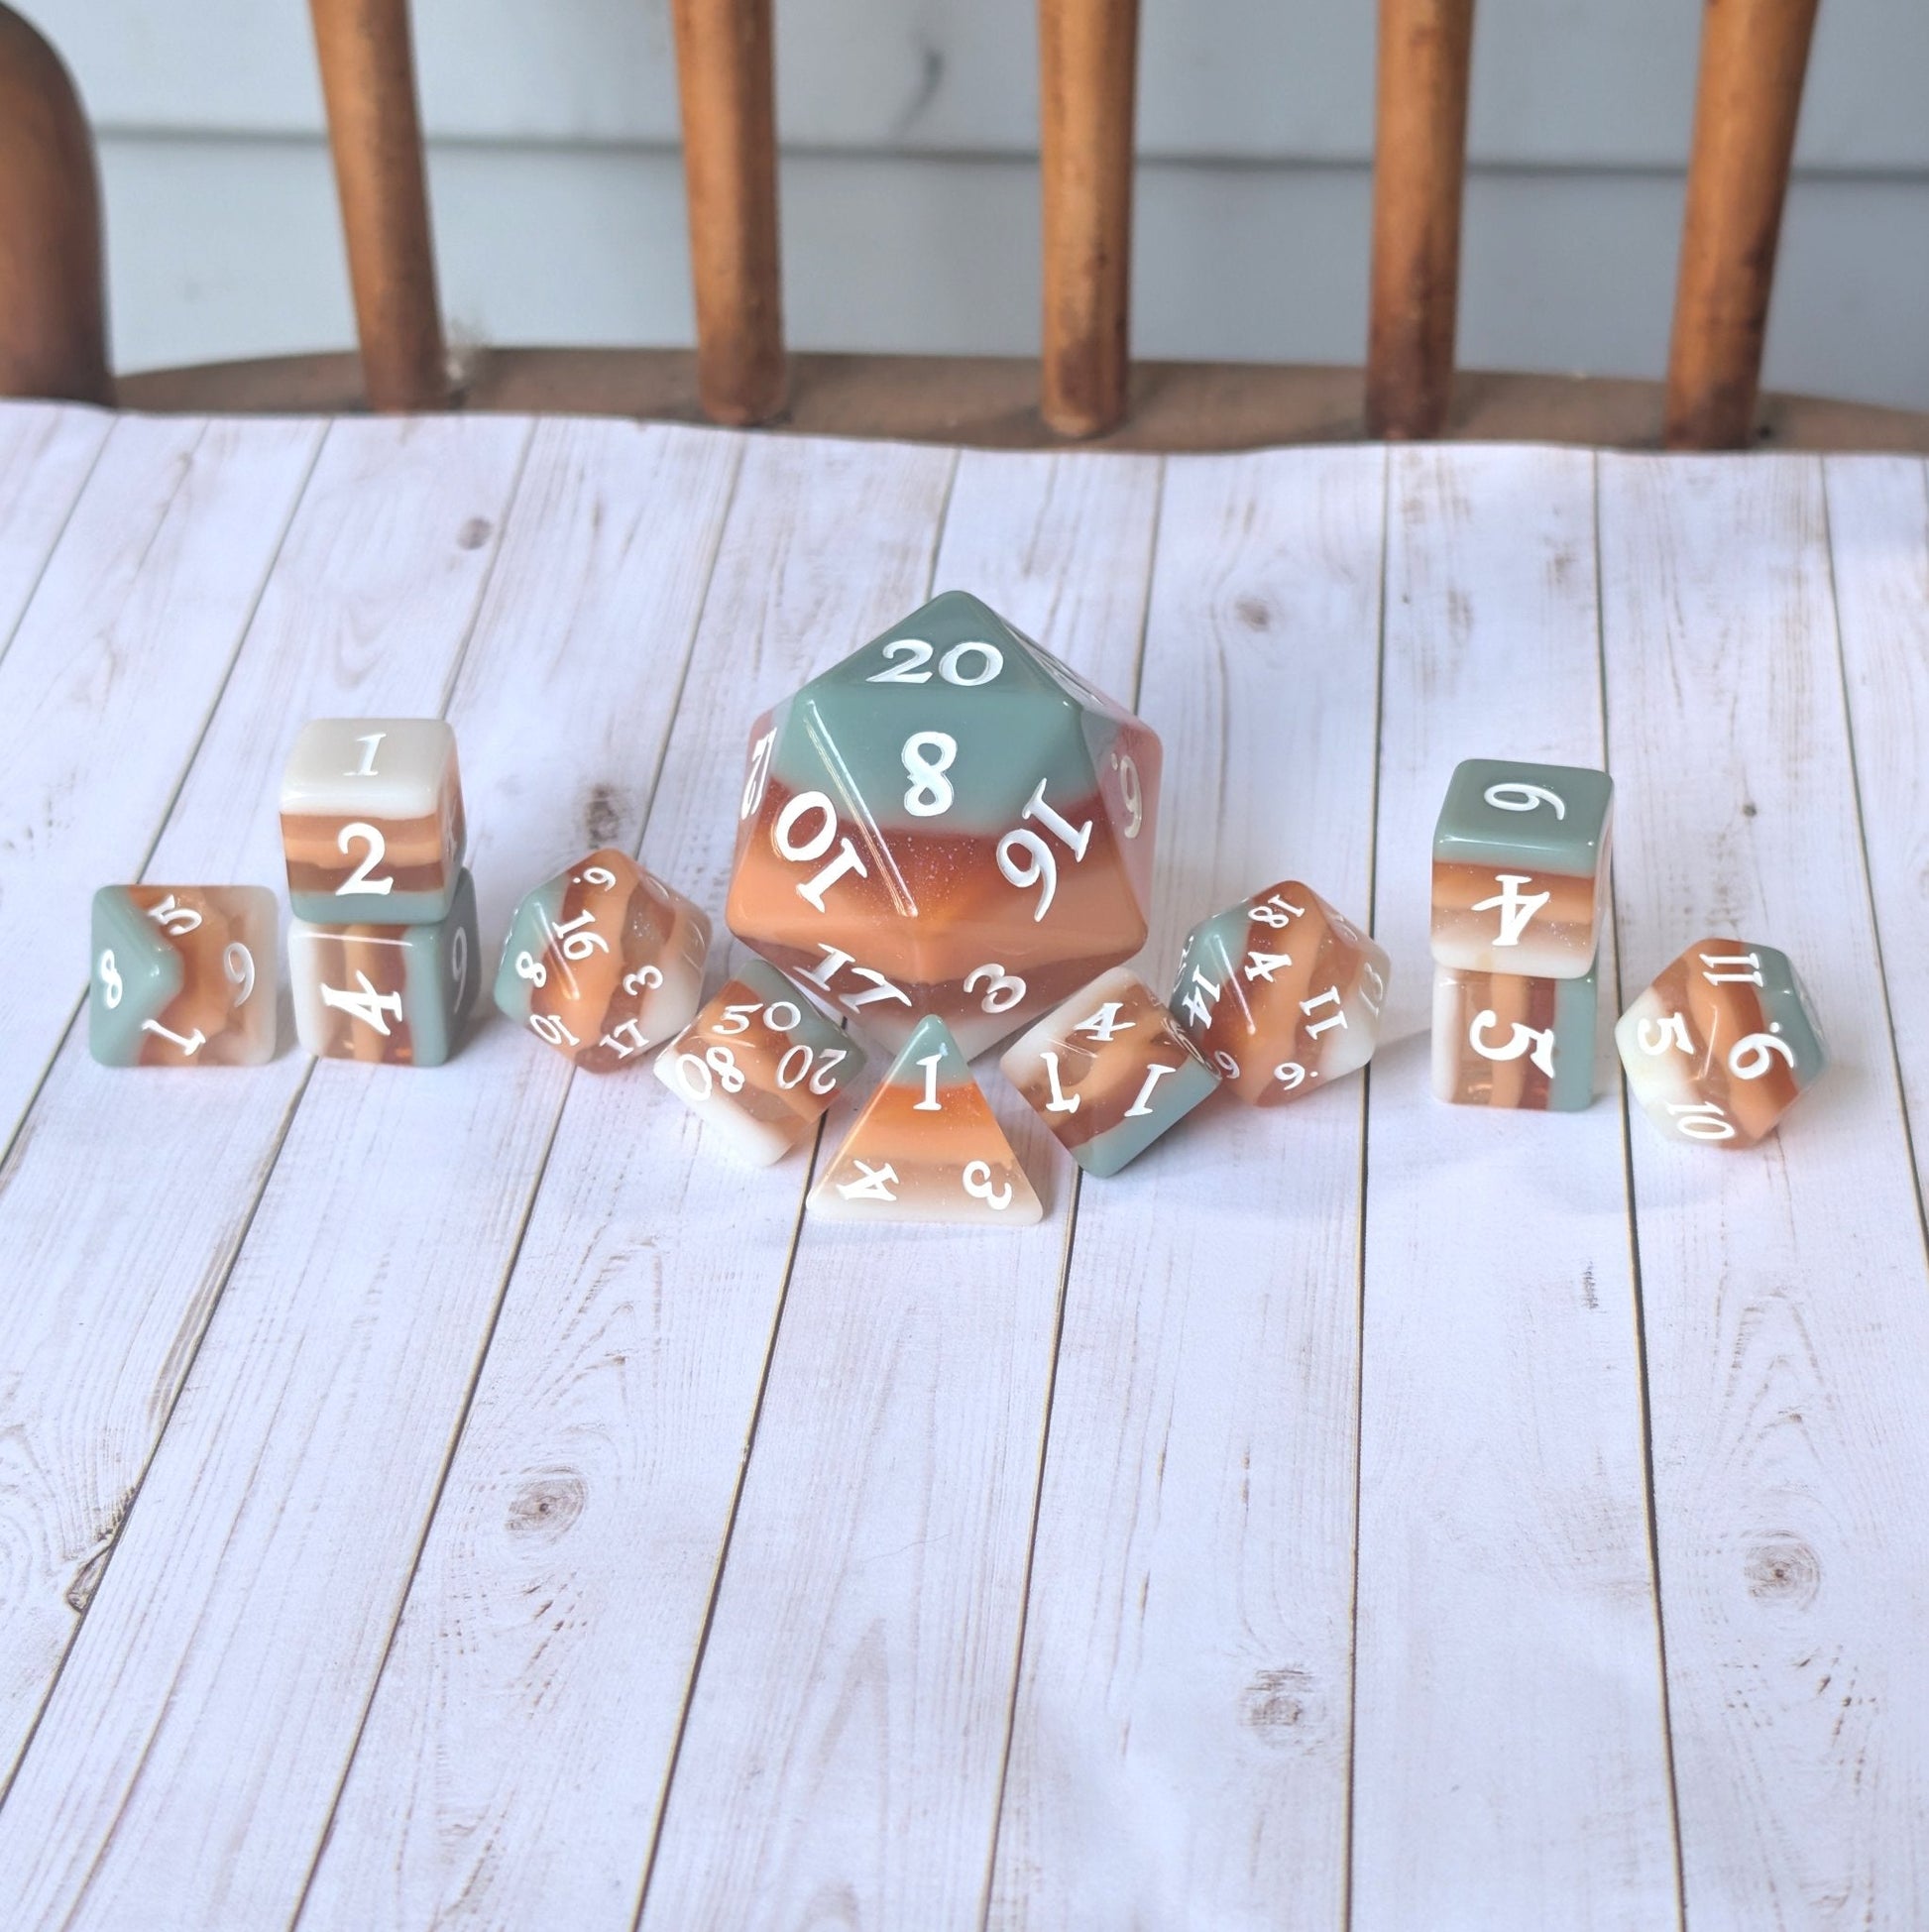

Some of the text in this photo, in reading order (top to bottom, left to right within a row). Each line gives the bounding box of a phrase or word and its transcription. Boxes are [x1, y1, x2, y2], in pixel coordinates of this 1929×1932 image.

[865, 639, 1003, 686] 20
[343, 733, 387, 776] 1
[901, 732, 958, 817] 8
[335, 823, 394, 896] 2
[776, 791, 867, 913] 10
[996, 777, 1093, 922] 16
[146, 895, 202, 936] 5
[1248, 894, 1305, 929] 18
[1471, 874, 1549, 946] 4
[552, 909, 610, 961] 16
[101, 950, 123, 1009] 8
[515, 952, 547, 988] 8
[623, 966, 663, 995] 3
[793, 944, 912, 1014] 17
[964, 963, 1026, 1013] 3
[1244, 952, 1292, 982] 4
[1699, 953, 1764, 987] 11
[319, 970, 402, 1036] 4
[712, 1001, 801, 1034] 50
[1074, 1002, 1136, 1041] 4
[1182, 965, 1221, 1029] 14
[1300, 985, 1348, 1040] 11
[141, 1018, 205, 1056] 1
[529, 1013, 580, 1047] 10
[1469, 1009, 1555, 1079] 5
[1637, 1012, 1694, 1056] 5
[675, 1046, 744, 1101] 80
[775, 1045, 847, 1094] 20
[912, 1053, 943, 1111] 1
[1123, 1063, 1176, 1117] 1
[1664, 1100, 1737, 1140] 10
[837, 1160, 899, 1202] 4
[963, 1161, 1011, 1210] 3
